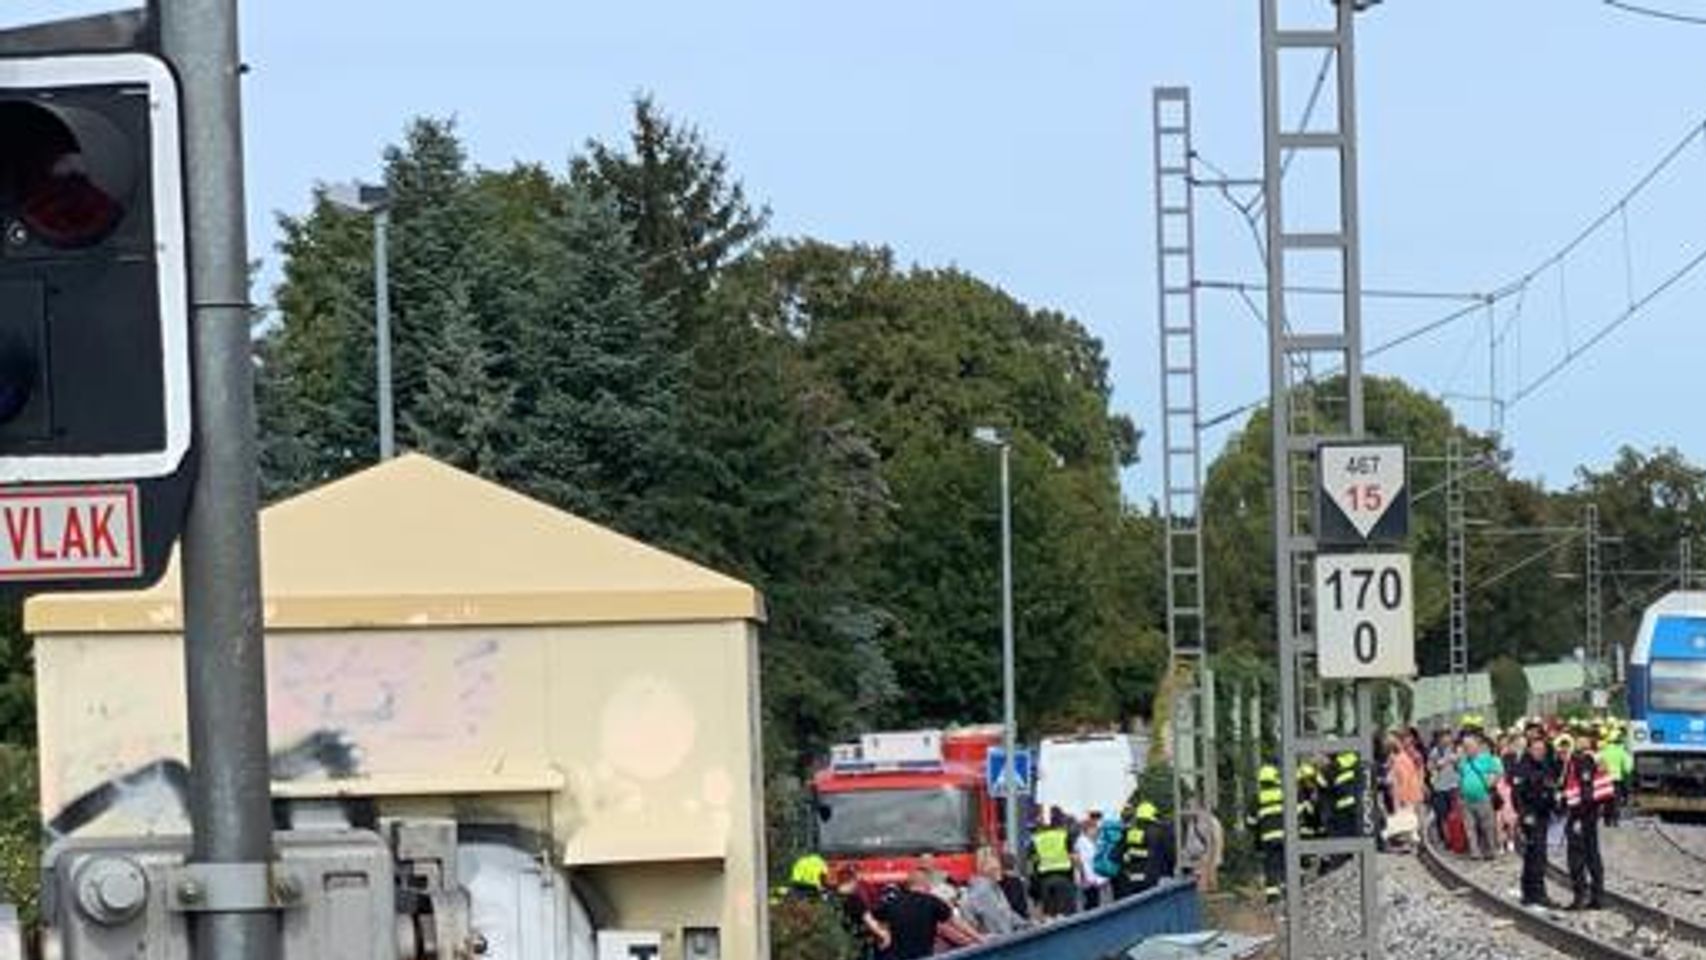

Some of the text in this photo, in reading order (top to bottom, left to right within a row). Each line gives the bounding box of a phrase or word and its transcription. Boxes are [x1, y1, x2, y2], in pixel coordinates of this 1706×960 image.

[1346, 456, 1381, 474] 467
[1345, 484, 1383, 511] 15
[4, 504, 118, 560] VLAK
[1325, 567, 1401, 611] 170
[1354, 620, 1378, 664] 0
